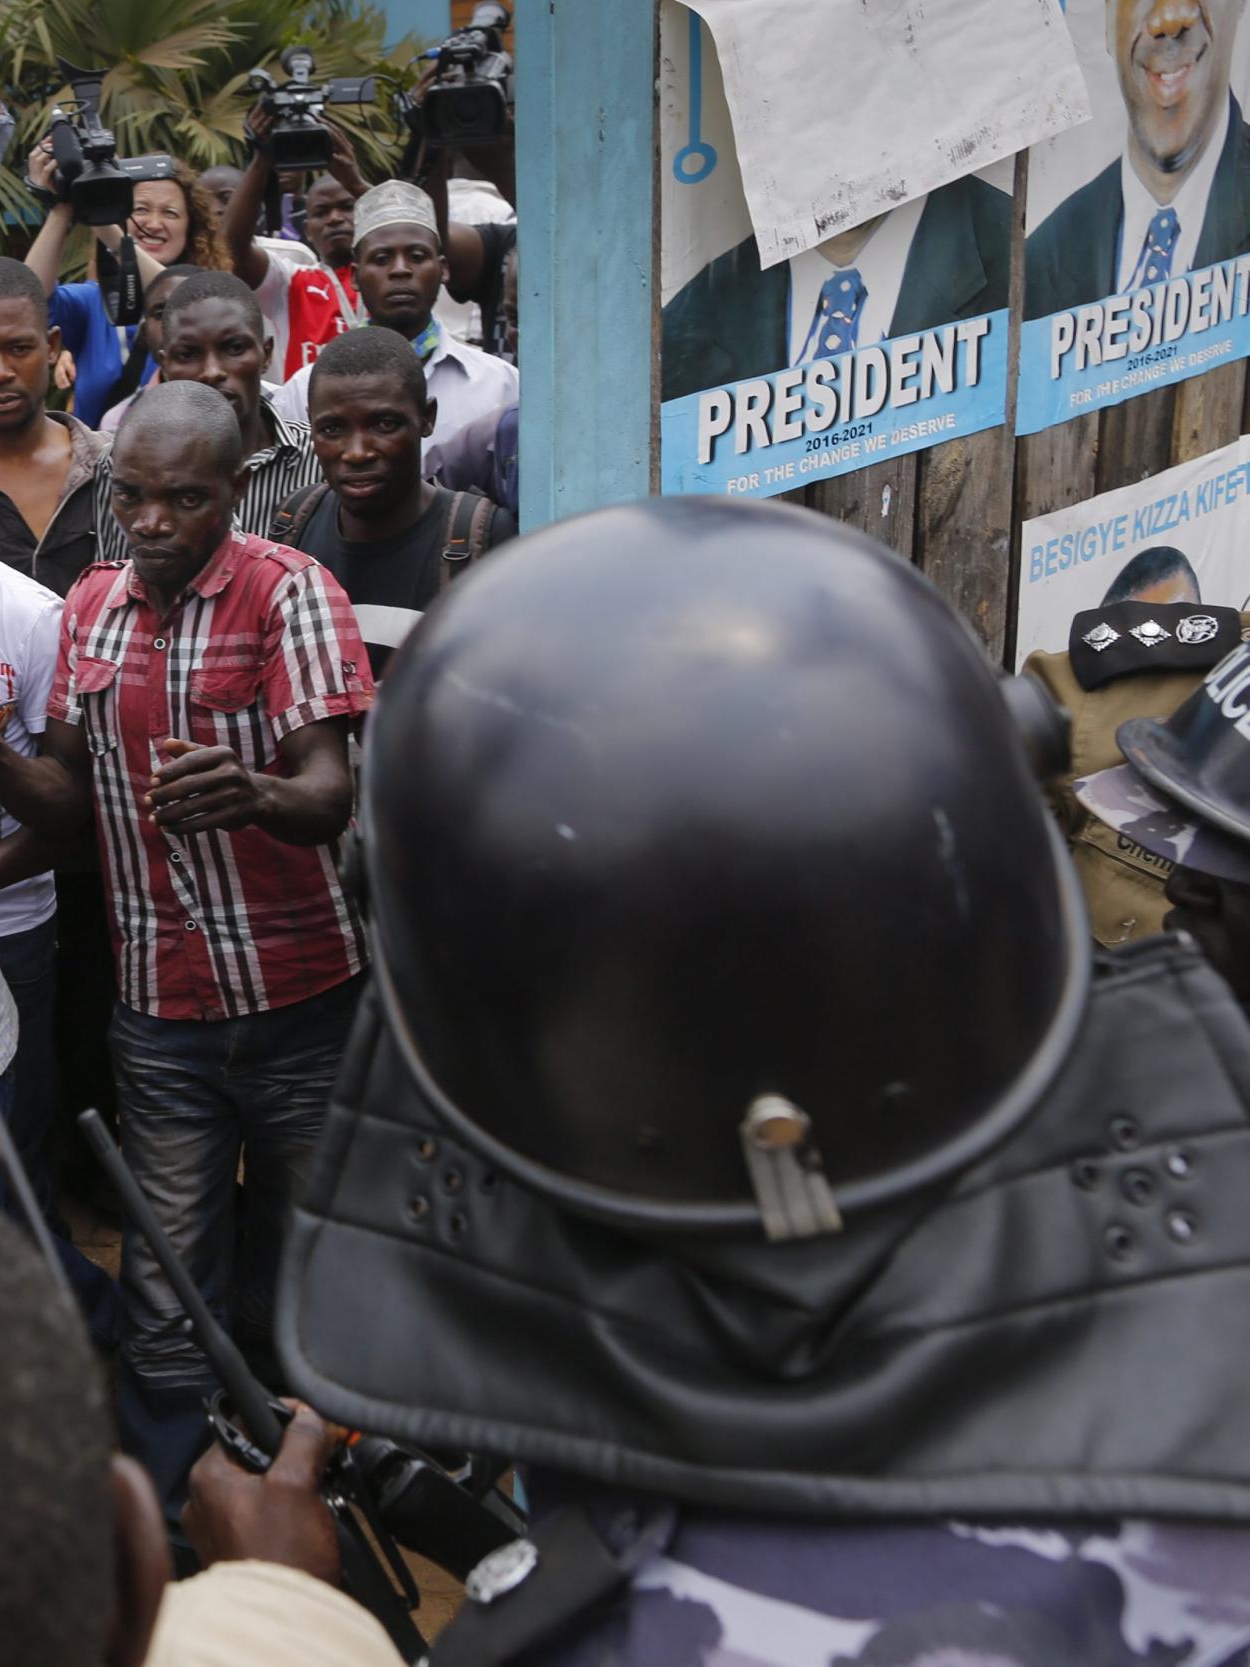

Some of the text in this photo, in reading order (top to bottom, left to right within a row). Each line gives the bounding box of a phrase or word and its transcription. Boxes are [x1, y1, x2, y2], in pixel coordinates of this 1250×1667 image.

[1050, 254, 1250, 380] PRESIDENT
[697, 317, 990, 466] PRESIDENT
[1069, 388, 1093, 408] FOR
[1120, 364, 1167, 390] CHANGE
[1170, 356, 1187, 372] WE
[726, 413, 956, 496] FOR THE CHANGE WE DESERVE
[805, 422, 874, 452] 2016-2021
[1029, 514, 1129, 583] BESIGYE
[1131, 490, 1190, 544] KIZZA
